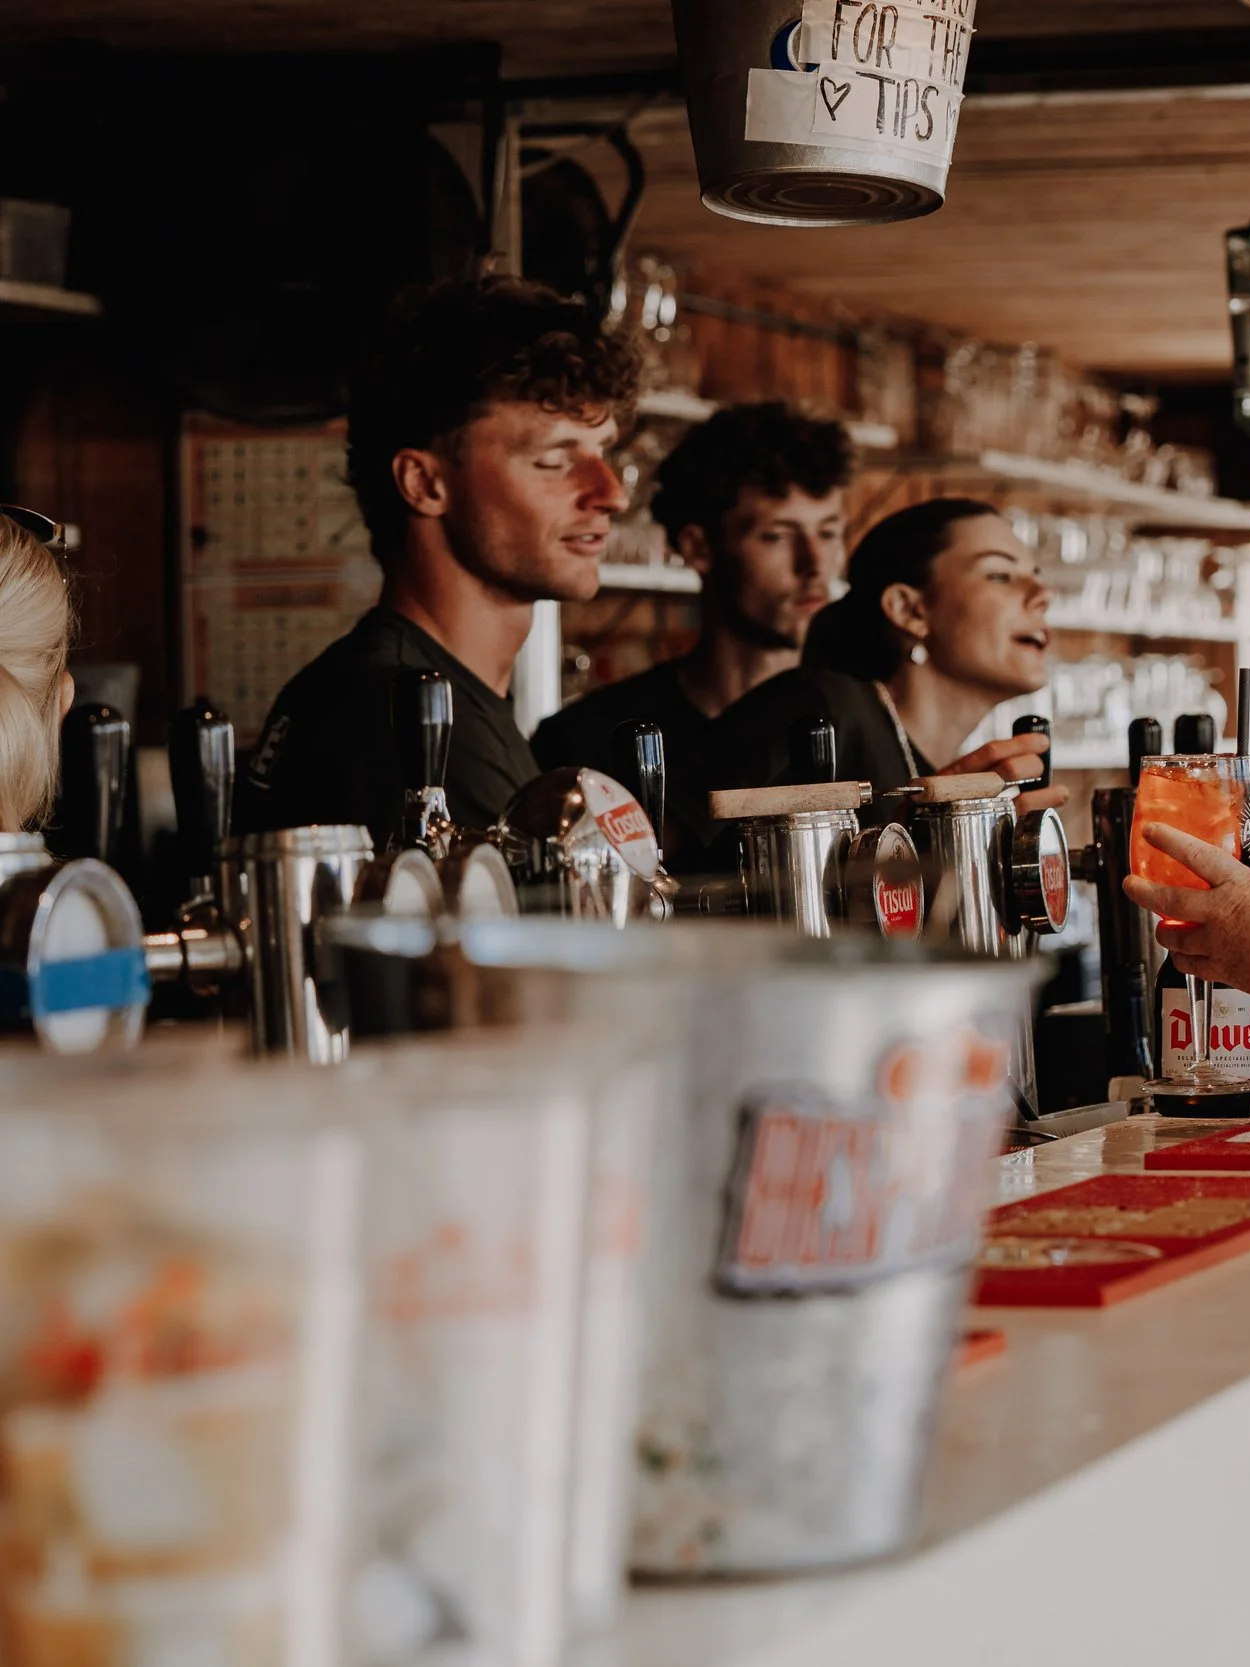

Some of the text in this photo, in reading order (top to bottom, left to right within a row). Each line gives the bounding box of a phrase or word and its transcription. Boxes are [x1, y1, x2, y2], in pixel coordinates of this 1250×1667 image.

[832, 0, 899, 69] FOR
[855, 71, 939, 142] TIPS
[876, 879, 914, 921] Cristal
